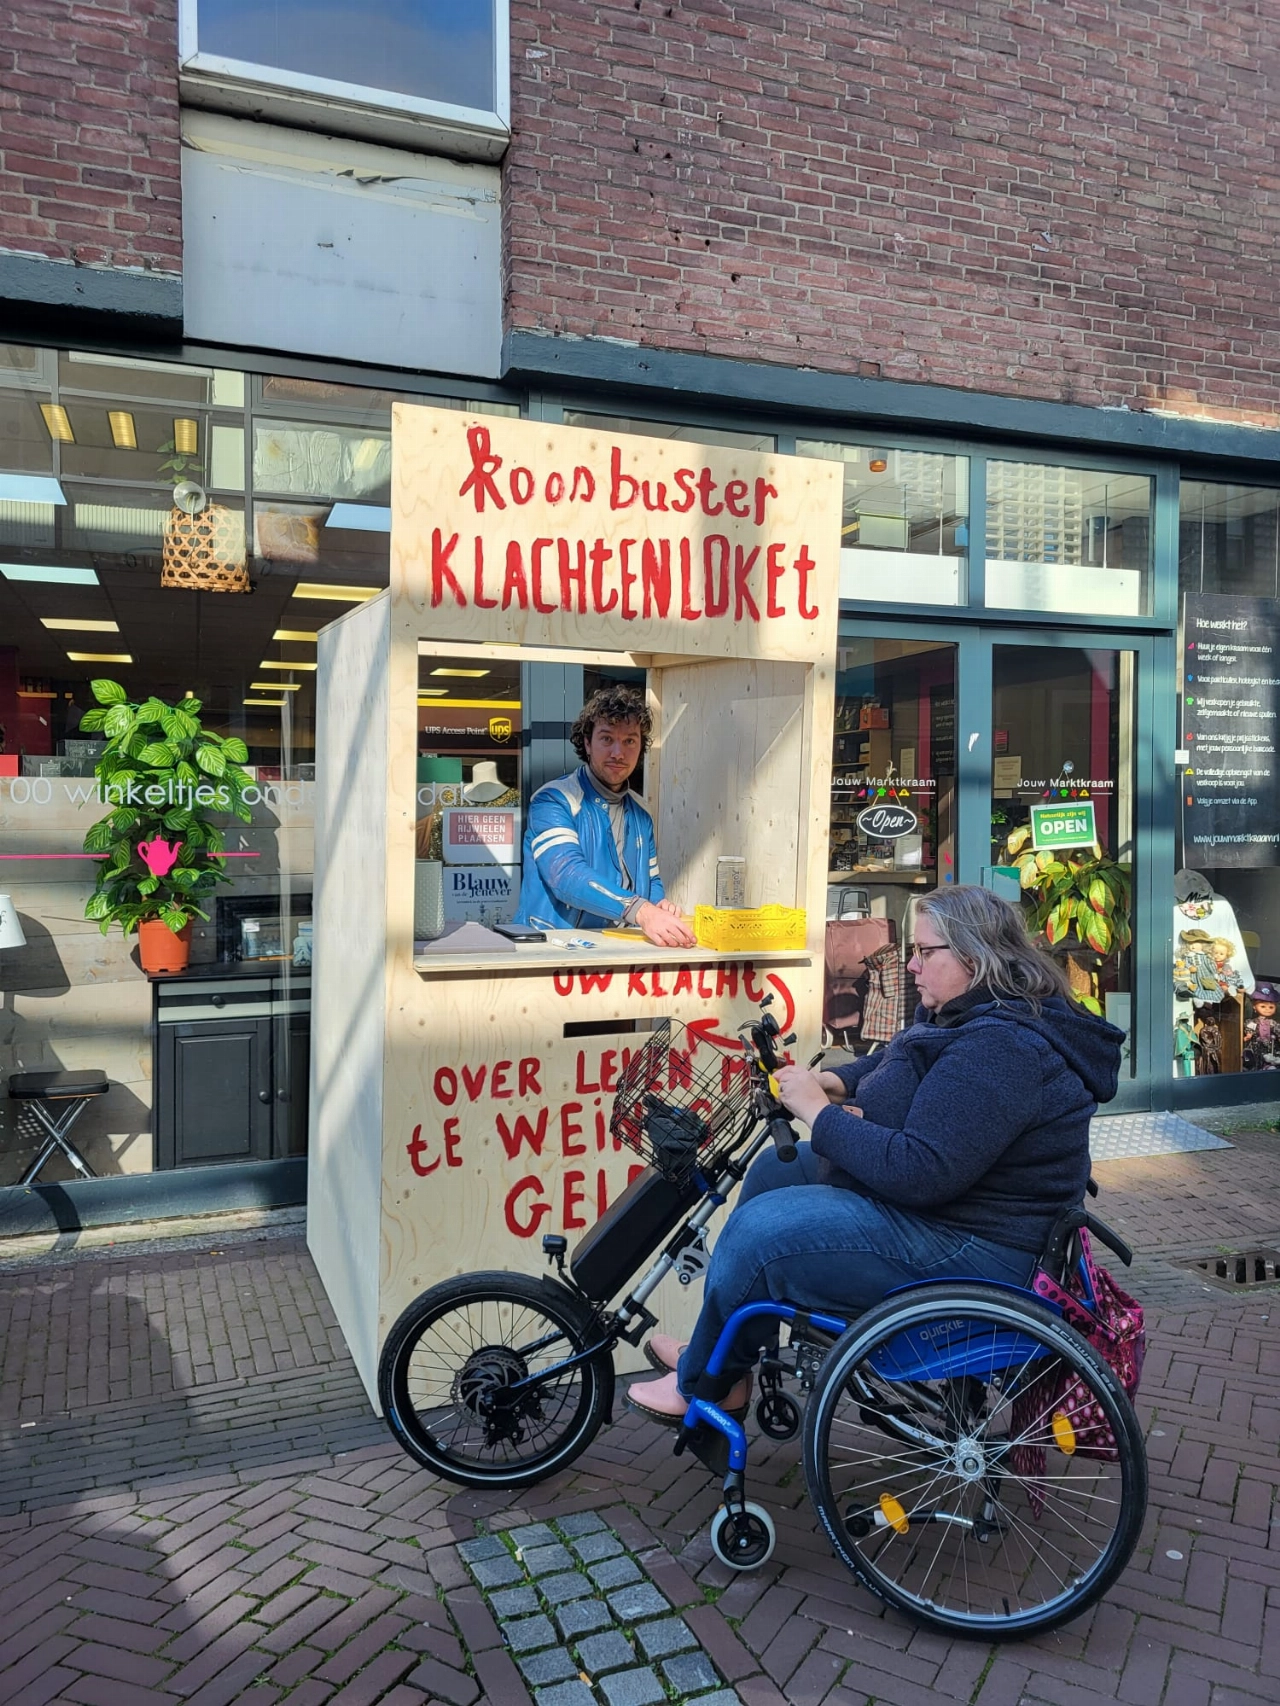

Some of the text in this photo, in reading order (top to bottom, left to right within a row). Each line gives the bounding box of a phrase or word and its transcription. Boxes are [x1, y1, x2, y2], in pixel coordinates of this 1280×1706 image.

[1196, 617, 1247, 631] Hoe werkt het?
[425, 726, 441, 734] UPS
[442, 727, 465, 735] Access
[831, 777, 936, 788] Jouw Marktkraam
[1017, 778, 1113, 788] Jouw Marktkraam
[63, 777, 230, 811] winkeltjes
[417, 781, 475, 806] dak
[457, 815, 506, 824] HIER GEEN
[872, 809, 904, 833] Open
[1040, 818, 1087, 835] OPEN
[457, 824, 506, 833] RIJWIELEN
[458, 834, 505, 843] PLAATSEN
[452, 872, 510, 890] Blauw
[469, 886, 512, 898] Jenever
[553, 968, 614, 997] UW
[433, 1056, 542, 1106] OVER
[920, 1320, 965, 1341] QUICKIE
